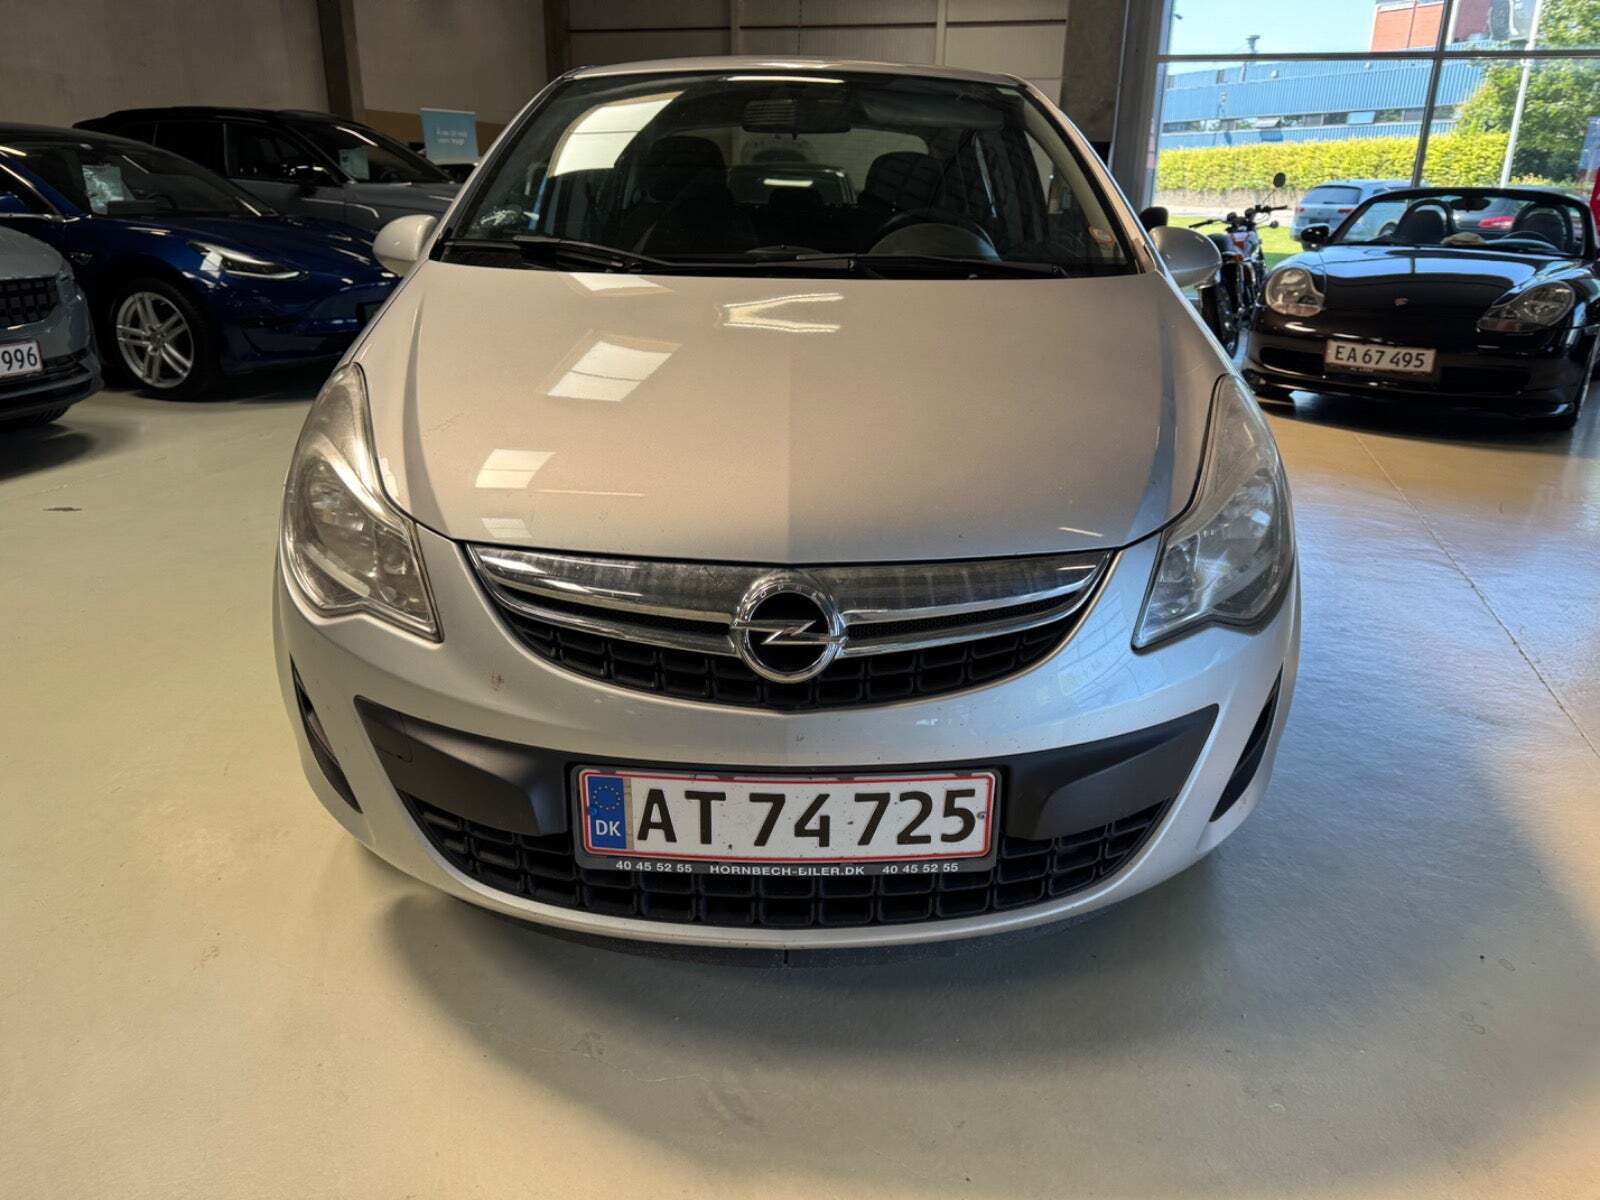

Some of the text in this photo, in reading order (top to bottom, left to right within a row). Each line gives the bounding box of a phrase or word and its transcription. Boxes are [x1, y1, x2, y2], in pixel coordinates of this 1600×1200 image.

[1, 346, 37, 371] 996
[1335, 345, 1425, 368] EA 67 495
[595, 819, 621, 837] DK
[637, 788, 976, 847] AT 74 725
[615, 860, 632, 870] 40
[635, 861, 652, 871] 45
[656, 862, 672, 872] 52
[677, 863, 693, 873] 55
[882, 865, 898, 875] 40
[902, 864, 918, 874] 45
[922, 863, 939, 873] 52
[943, 861, 959, 872] 55
